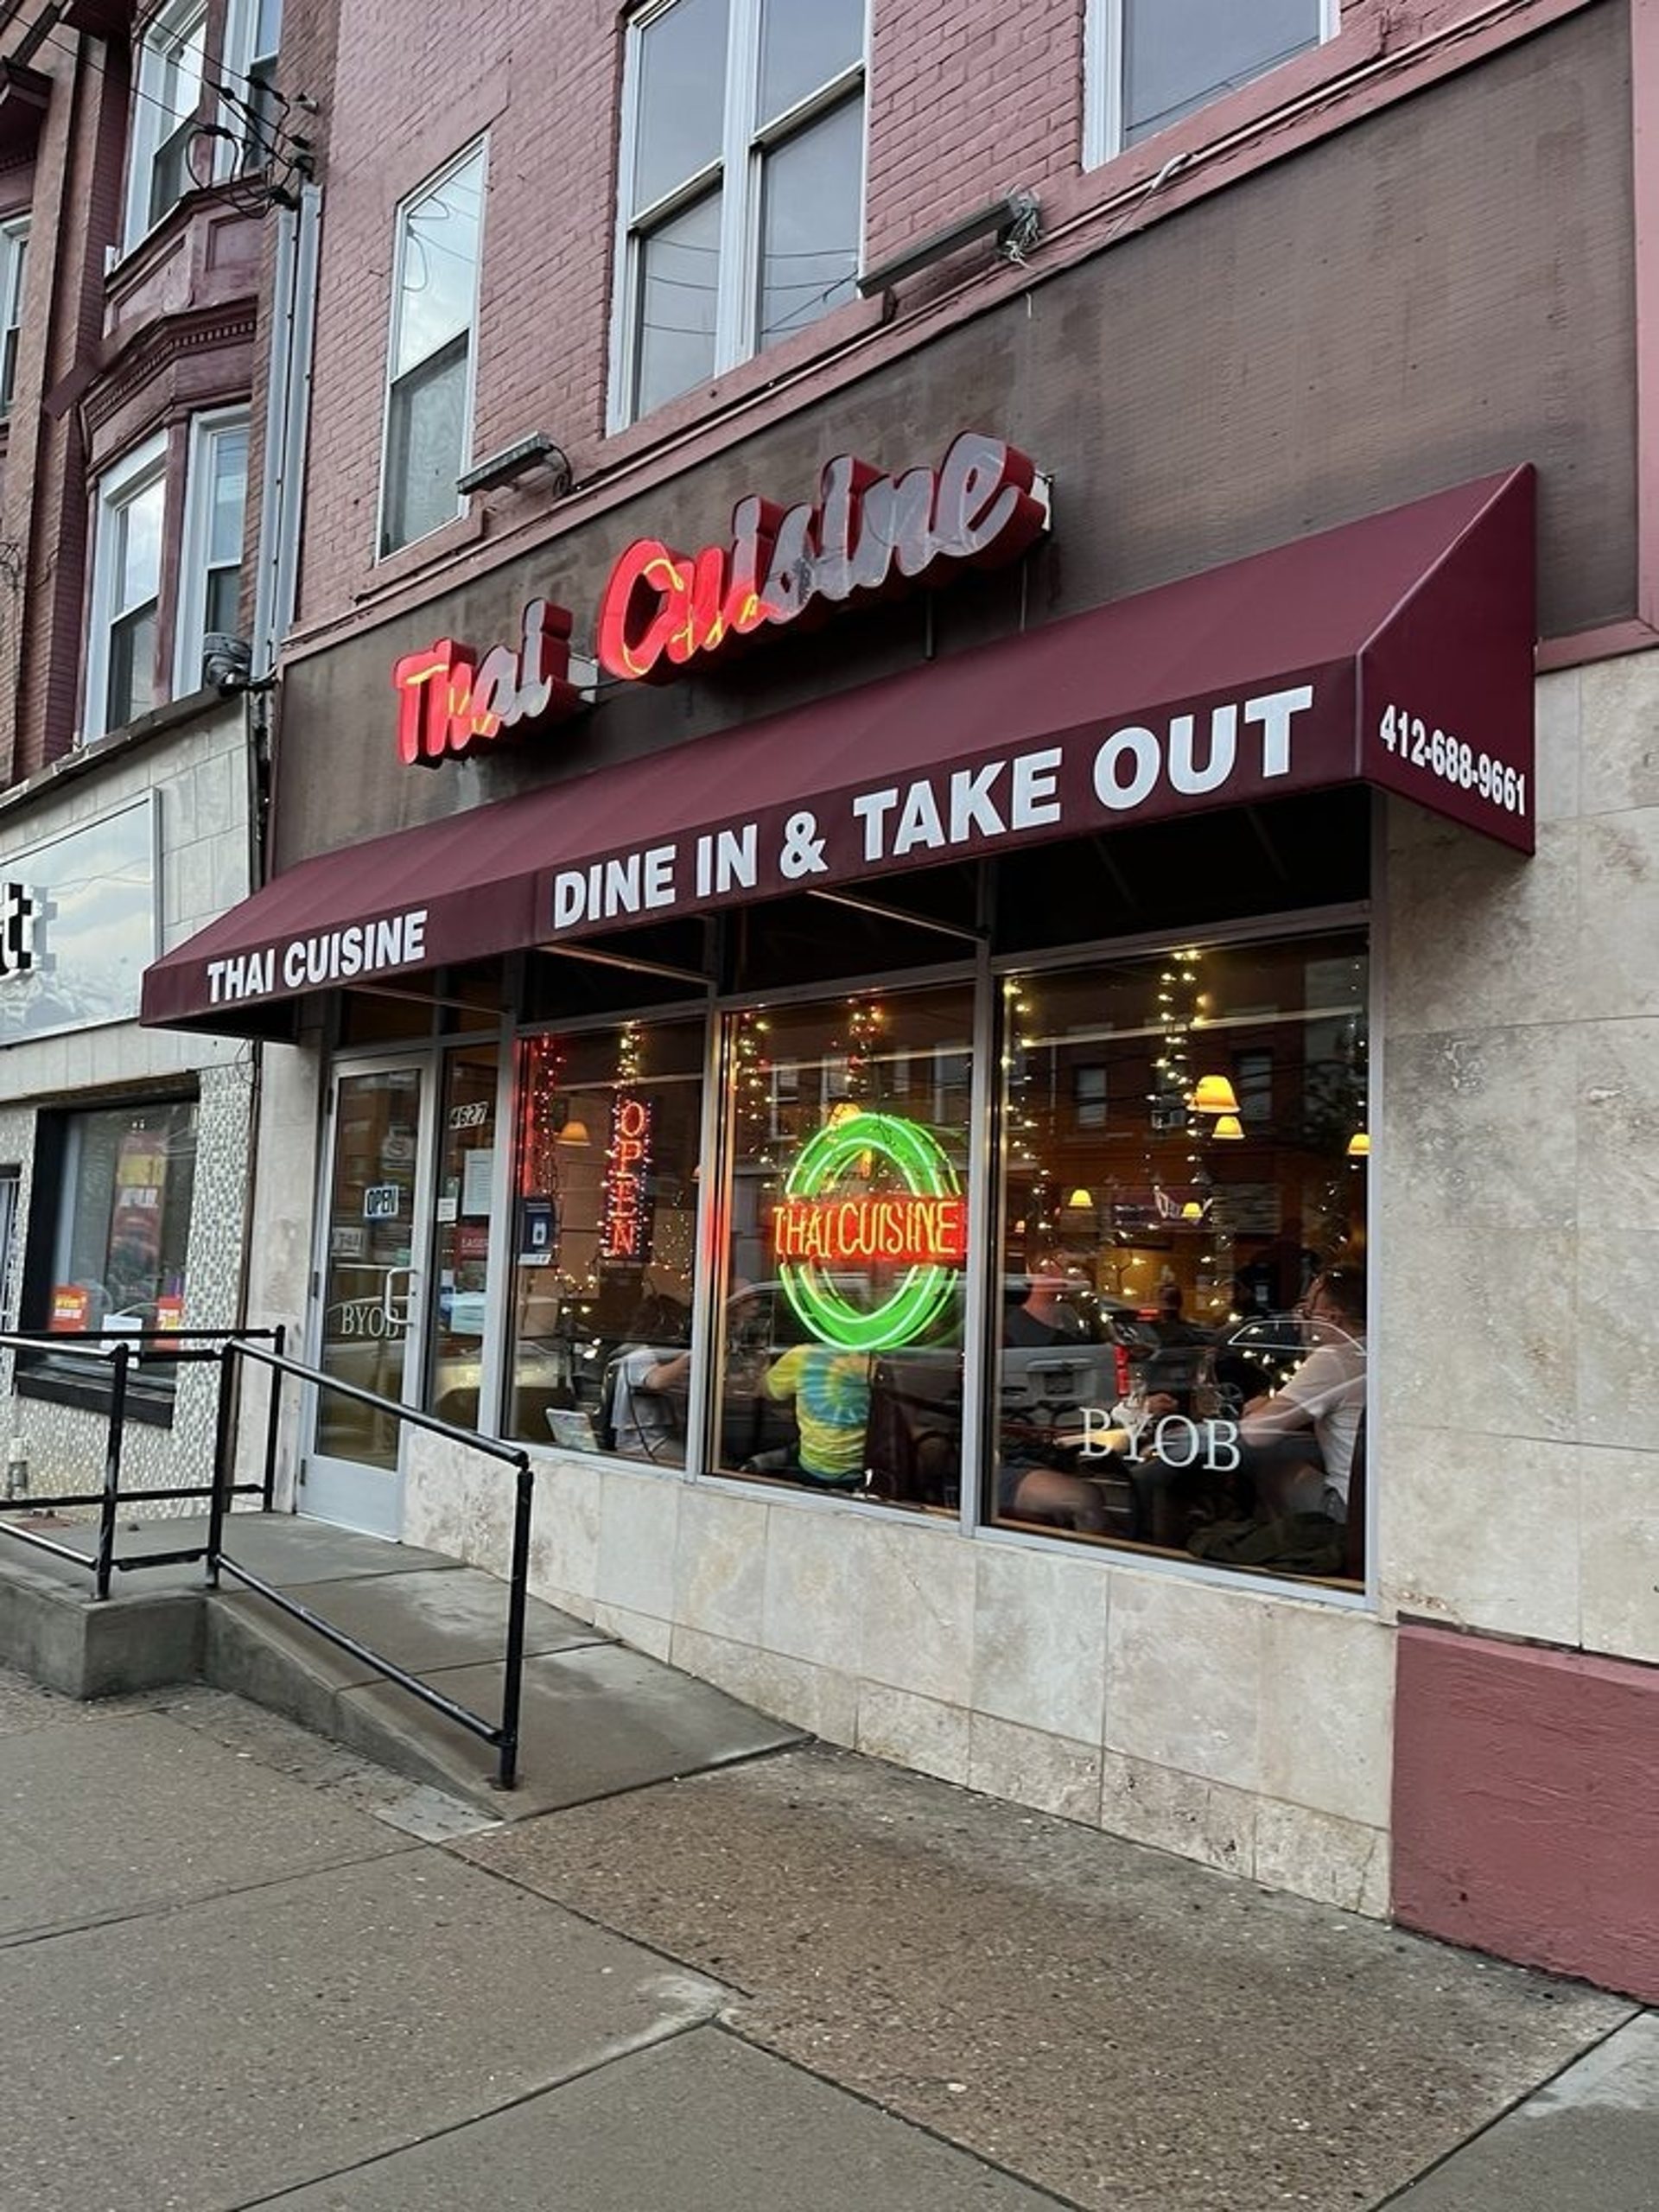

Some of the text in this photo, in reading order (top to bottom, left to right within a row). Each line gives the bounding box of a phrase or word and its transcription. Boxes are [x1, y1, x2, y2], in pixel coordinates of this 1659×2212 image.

[393, 430, 1047, 766] Thai Cuisine
[1379, 703, 1526, 817] 412-688-9661
[553, 684, 1313, 930] DINE IN & TAKE OUT
[207, 910, 428, 1003] THAI CUISINE
[366, 1188, 397, 1216] OPEN
[611, 1100, 645, 1255] OPEN
[772, 1202, 959, 1259] THAI CUISINE
[340, 1303, 399, 1339] BYOB
[1079, 1407, 1243, 1471] BYOB
